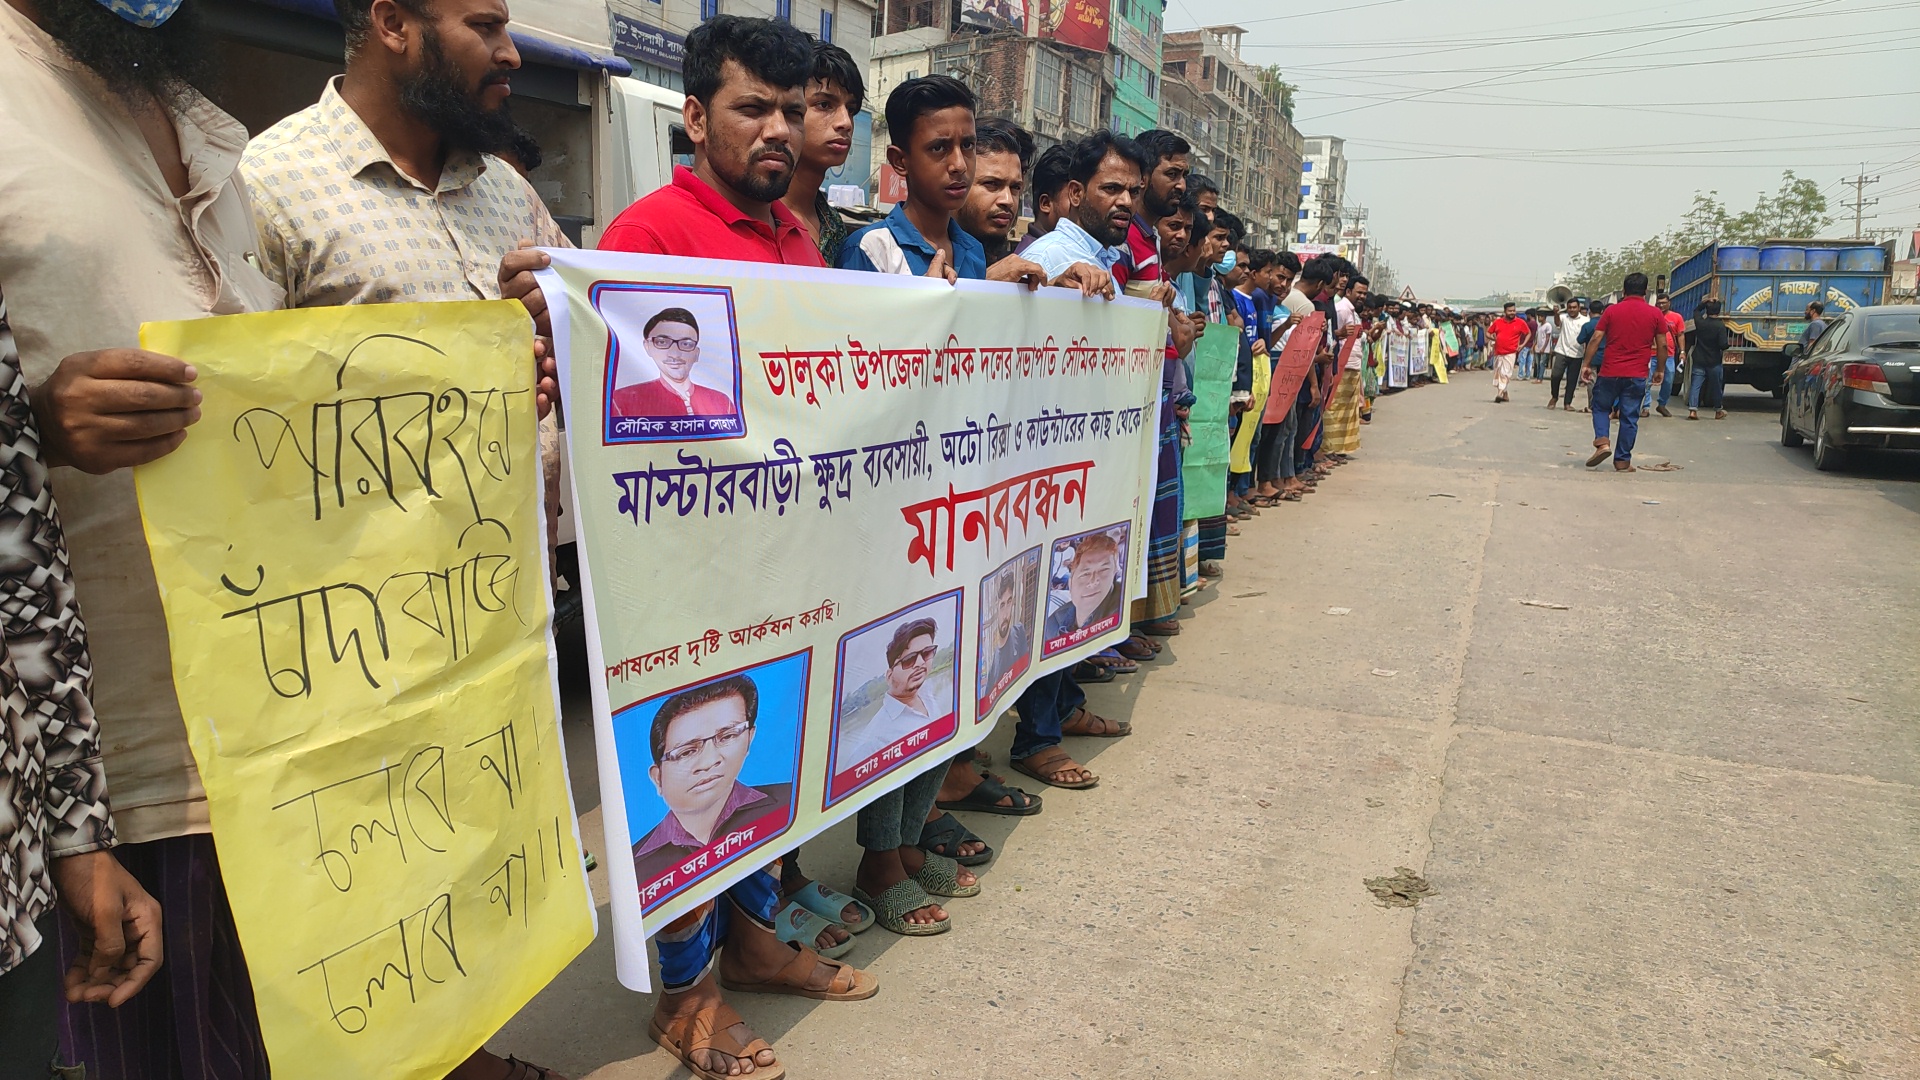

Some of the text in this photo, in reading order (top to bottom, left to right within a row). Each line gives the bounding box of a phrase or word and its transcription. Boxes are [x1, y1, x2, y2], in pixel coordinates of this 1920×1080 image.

[642, 45, 659, 56] FIRST
[1736, 285, 1774, 314] নামাজ
[1780, 281, 1821, 296] কায়েম
[758, 344, 845, 410] ভালুকা
[847, 334, 932, 392] উপজেলা
[933, 333, 976, 388] শ্রমিক
[979, 347, 1014, 384] দলের
[1015, 335, 1060, 382] সভাপতি
[1061, 335, 1100, 378] সৌমিক
[1101, 343, 1127, 378] হাসান
[615, 417, 738, 434] সৌমিক হাসান সোহাগ
[612, 437, 804, 527] মাস্টারবাড়ী
[808, 448, 858, 515] ক্ষুদ্র
[861, 420, 933, 490] ব্যবসায়ী,
[939, 416, 984, 469] অটো
[1013, 420, 1023, 452] ও
[1026, 404, 1088, 450] কাউন্টারের
[1090, 407, 1114, 442] কাছ
[1115, 405, 1142, 438] থেকে
[900, 460, 1096, 579] মানববন্ধন
[686, 628, 724, 667] দৃষ্টি
[854, 757, 879, 779] মোঃ
[906, 728, 931, 748] লাল
[271, 746, 455, 893] চলবে
[680, 850, 710, 875] অর
[712, 825, 758, 859] রশিদ
[297, 892, 467, 1034] চলবে
